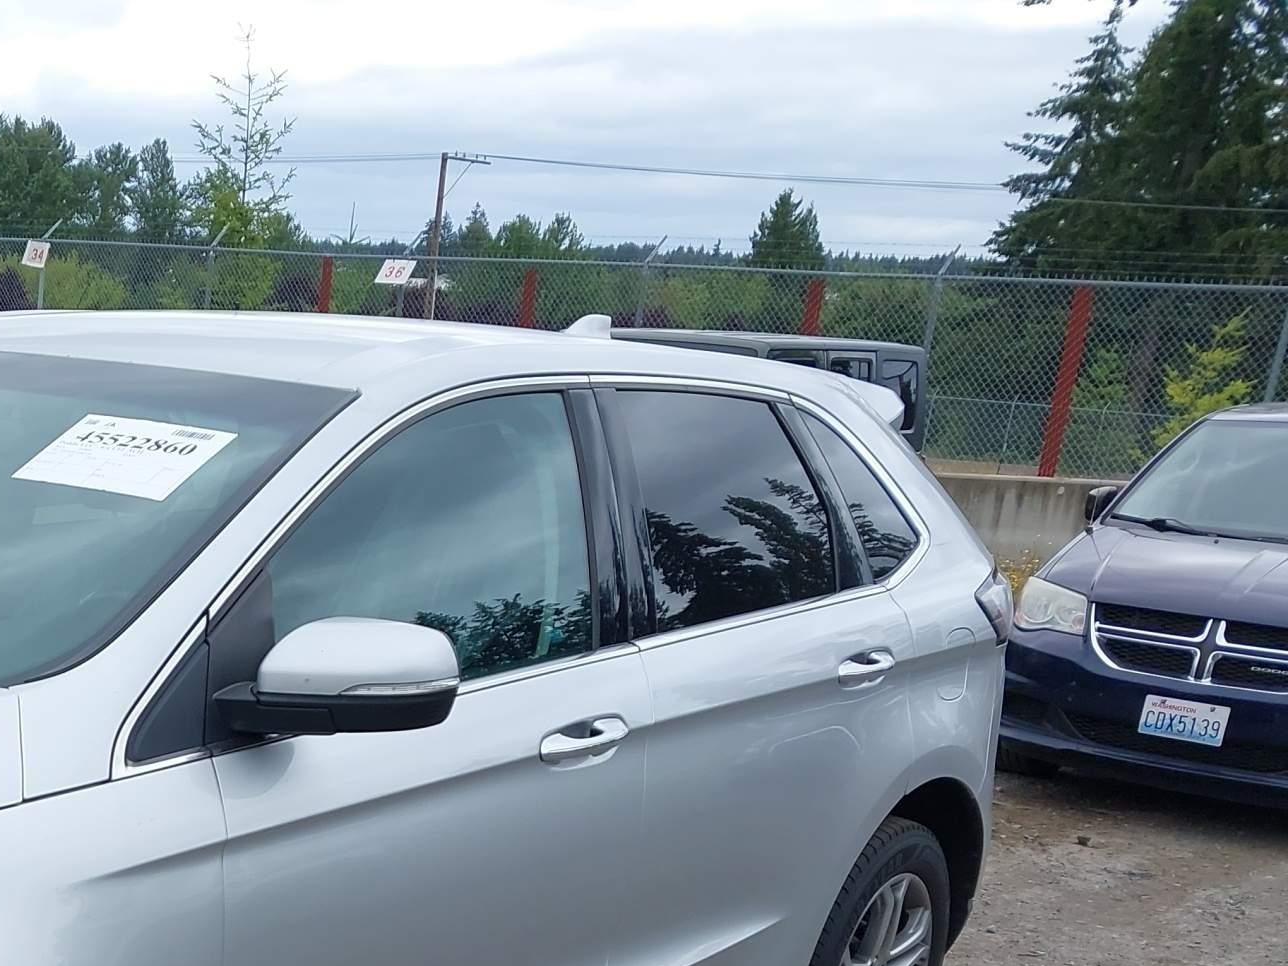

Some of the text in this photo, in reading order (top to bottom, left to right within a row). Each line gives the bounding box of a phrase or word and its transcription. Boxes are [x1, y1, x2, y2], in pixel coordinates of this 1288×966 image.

[31, 248, 44, 262] 34
[384, 265, 405, 278] 36
[76, 430, 198, 456] 45522860
[1151, 701, 1197, 714] WASHINGTON
[1144, 709, 1222, 739] CDX5139
